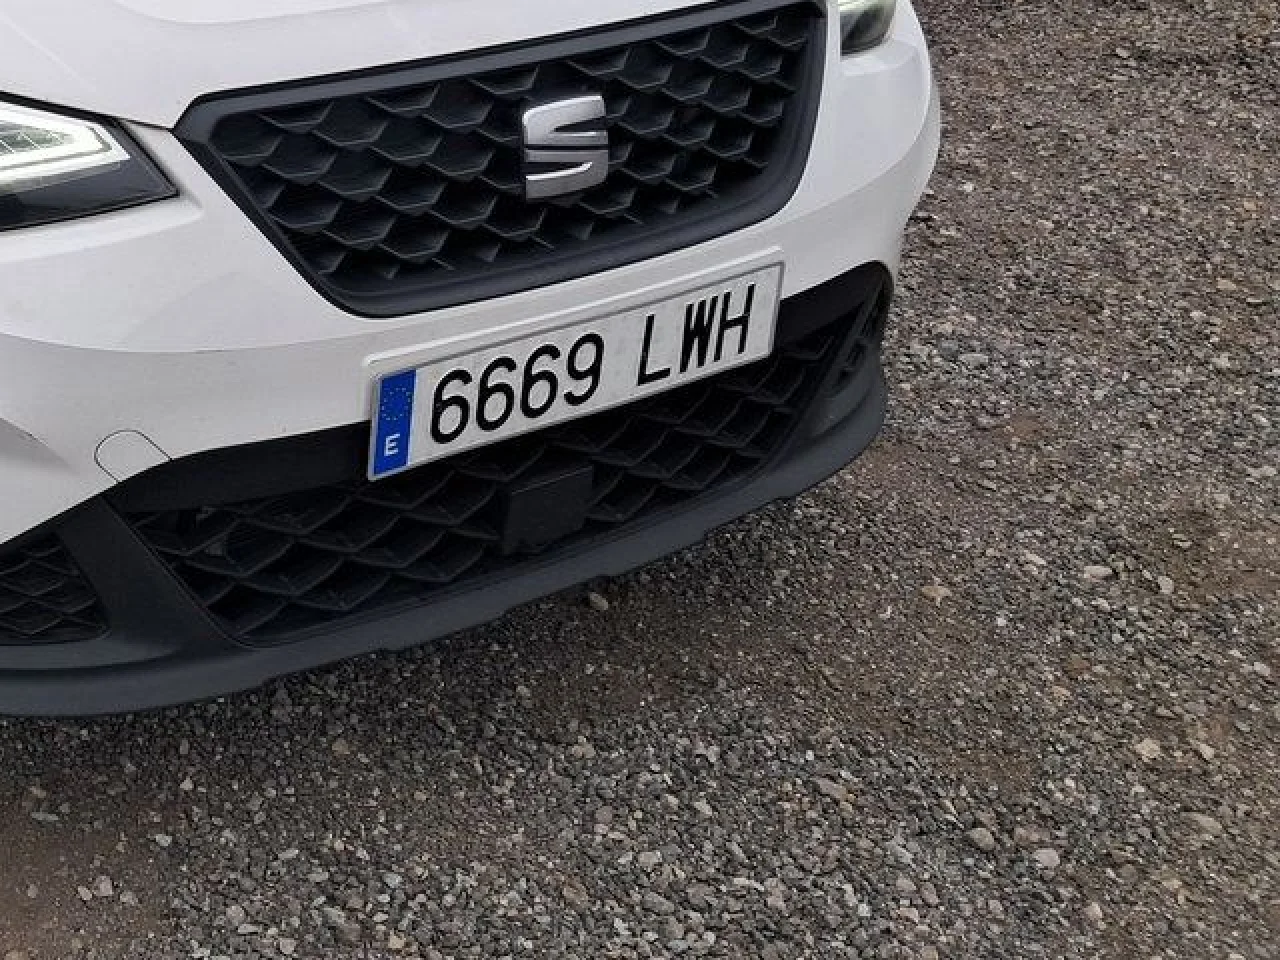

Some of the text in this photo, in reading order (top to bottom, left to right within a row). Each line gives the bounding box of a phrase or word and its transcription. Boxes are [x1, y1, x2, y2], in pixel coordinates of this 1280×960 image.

[430, 283, 757, 445] 6669 LWH
[384, 434, 399, 457] E
